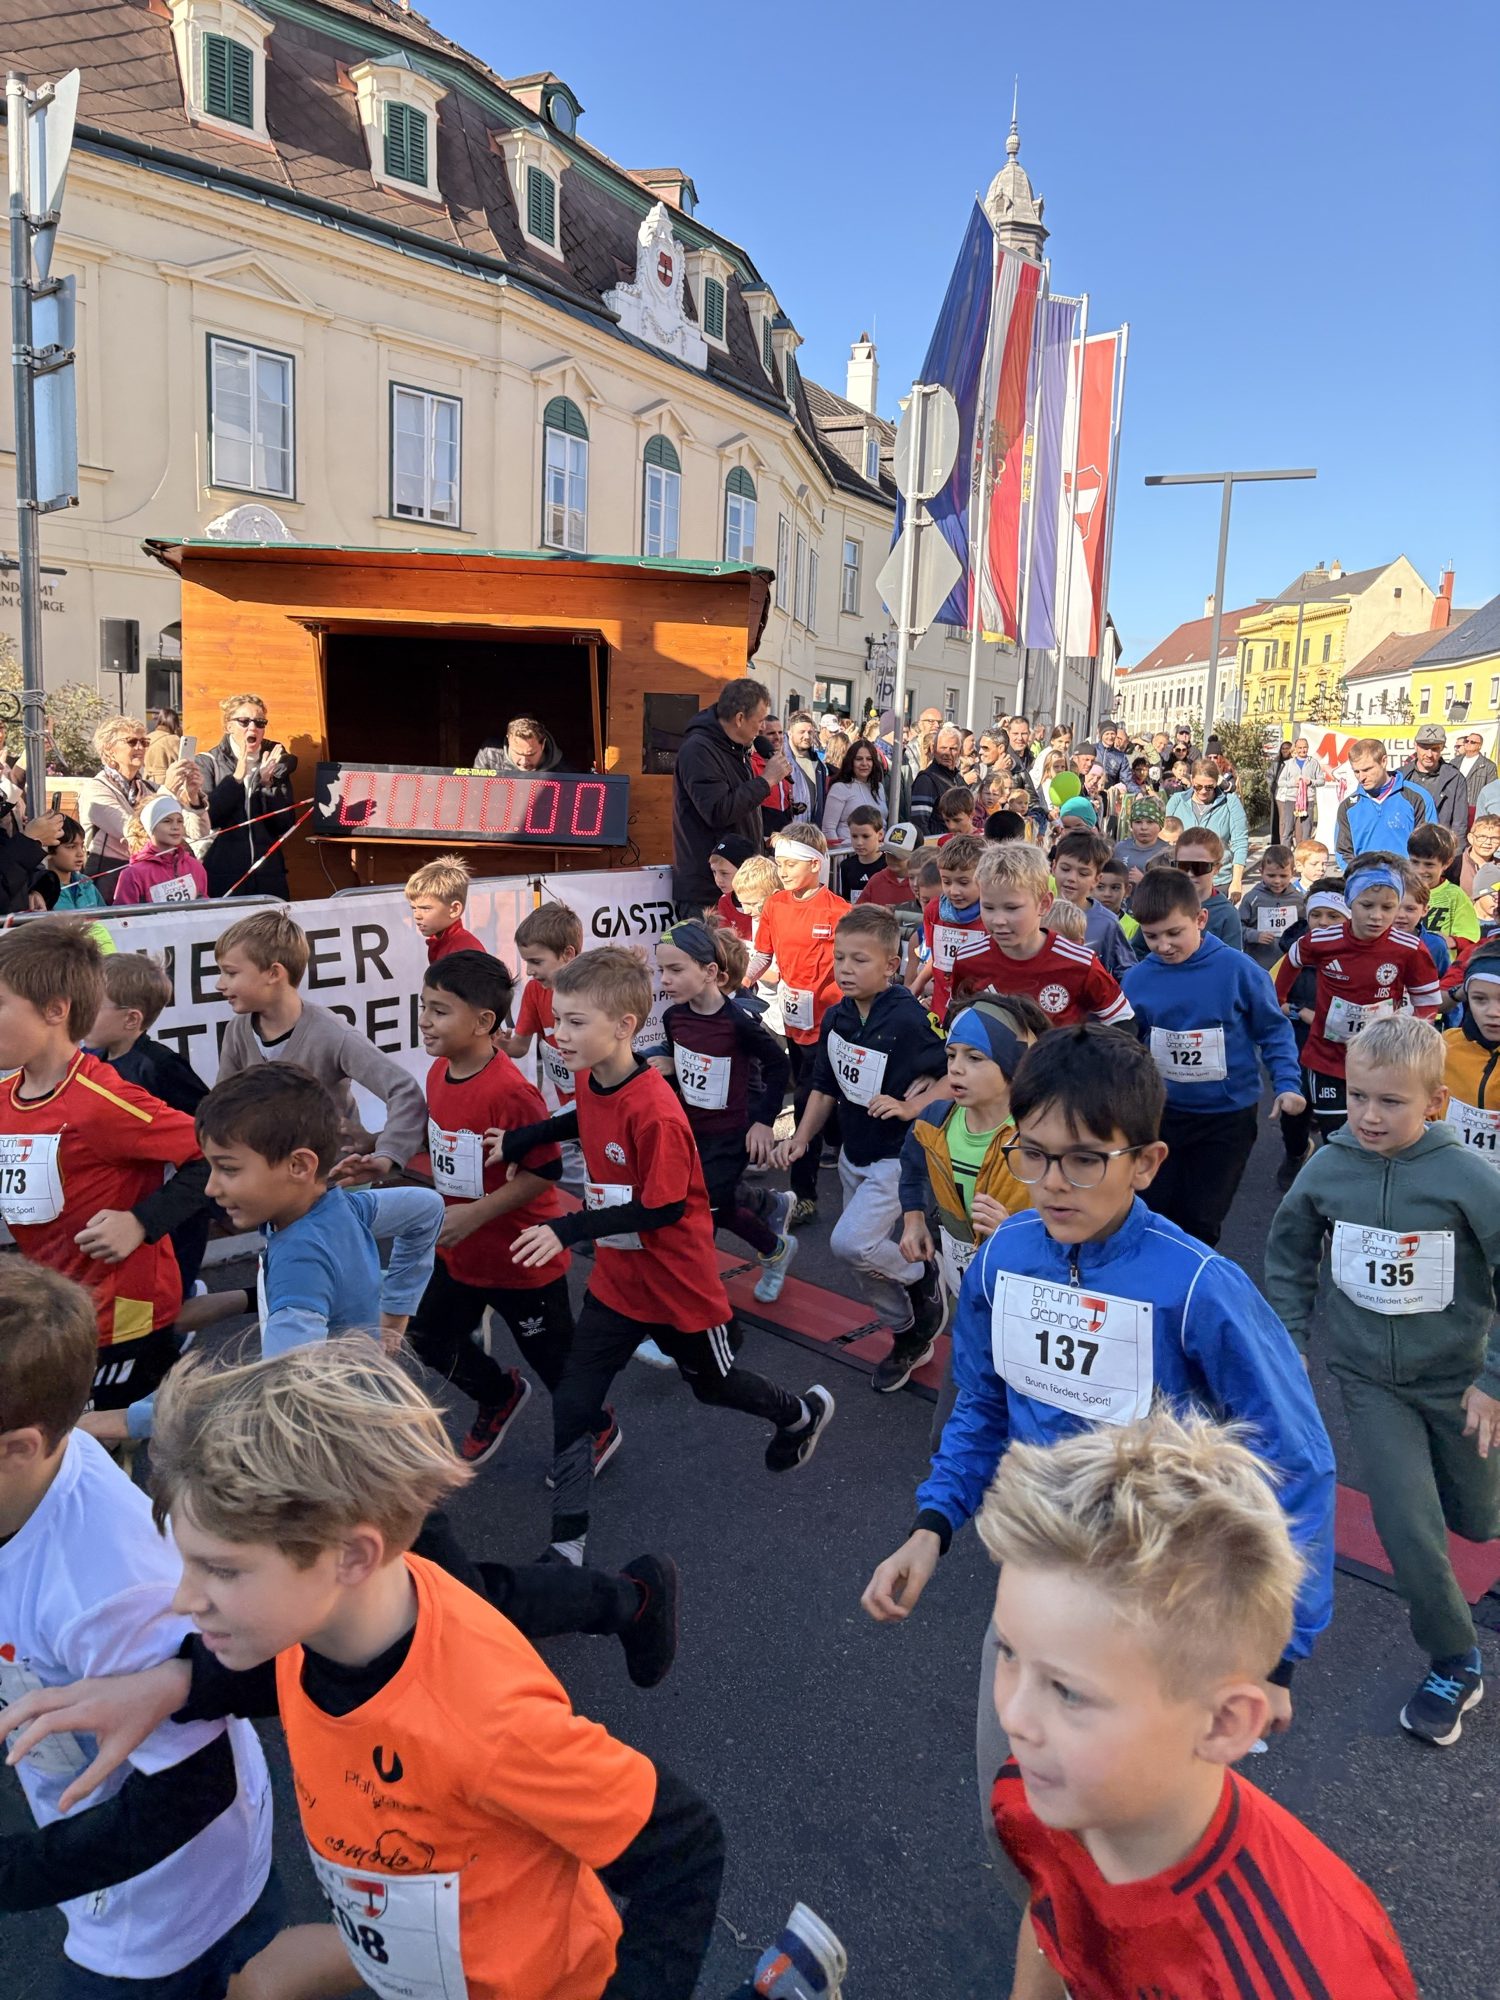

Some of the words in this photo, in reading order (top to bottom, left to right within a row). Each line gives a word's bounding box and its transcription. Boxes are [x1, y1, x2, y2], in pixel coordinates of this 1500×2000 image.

[944, 944, 961, 958] 18
[1171, 1050, 1203, 1066] 122
[550, 1063, 569, 1080] 169
[682, 1069, 707, 1090] 212
[837, 1060, 860, 1084] 148
[1318, 1087, 1337, 1099] JBS
[1463, 1128, 1497, 1150] 141
[432, 1149, 455, 1175] 145
[1362, 1230, 1398, 1245] brunn
[1365, 1260, 1414, 1287] 135
[1032, 1298, 1047, 1308] am
[1033, 1285, 1080, 1307] brunn
[1356, 1291, 1375, 1302] Brunn
[1030, 1306, 1088, 1331] gebirge
[1035, 1330, 1099, 1376] 137
[1025, 1375, 1049, 1391] Brunn
[1050, 1383, 1081, 1401] fördert
[1082, 1391, 1112, 1407] Sport!
